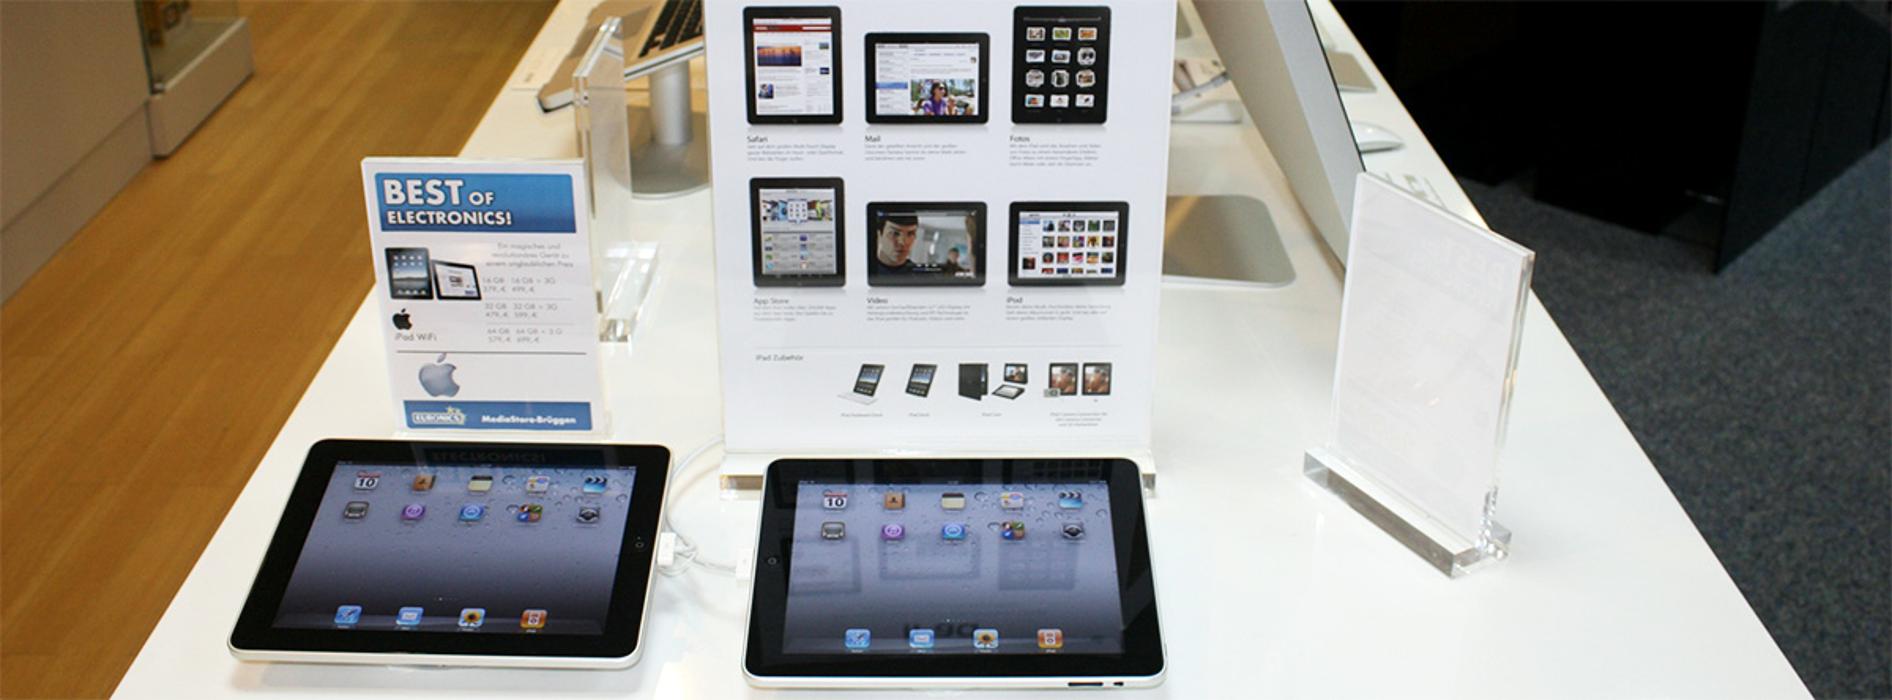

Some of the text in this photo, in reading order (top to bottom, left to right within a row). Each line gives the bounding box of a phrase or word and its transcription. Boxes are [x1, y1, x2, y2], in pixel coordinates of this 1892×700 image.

[746, 135, 768, 144] Safari
[865, 135, 881, 143] Mail
[1009, 135, 1031, 143] Fotos
[383, 179, 494, 206] BEST OF
[387, 210, 512, 225] ELECTRONICS!
[395, 333, 437, 342] iPad WiFi
[481, 415, 576, 426] MediaStore-Brüggen
[360, 478, 376, 488] 10
[828, 498, 844, 507] 10
